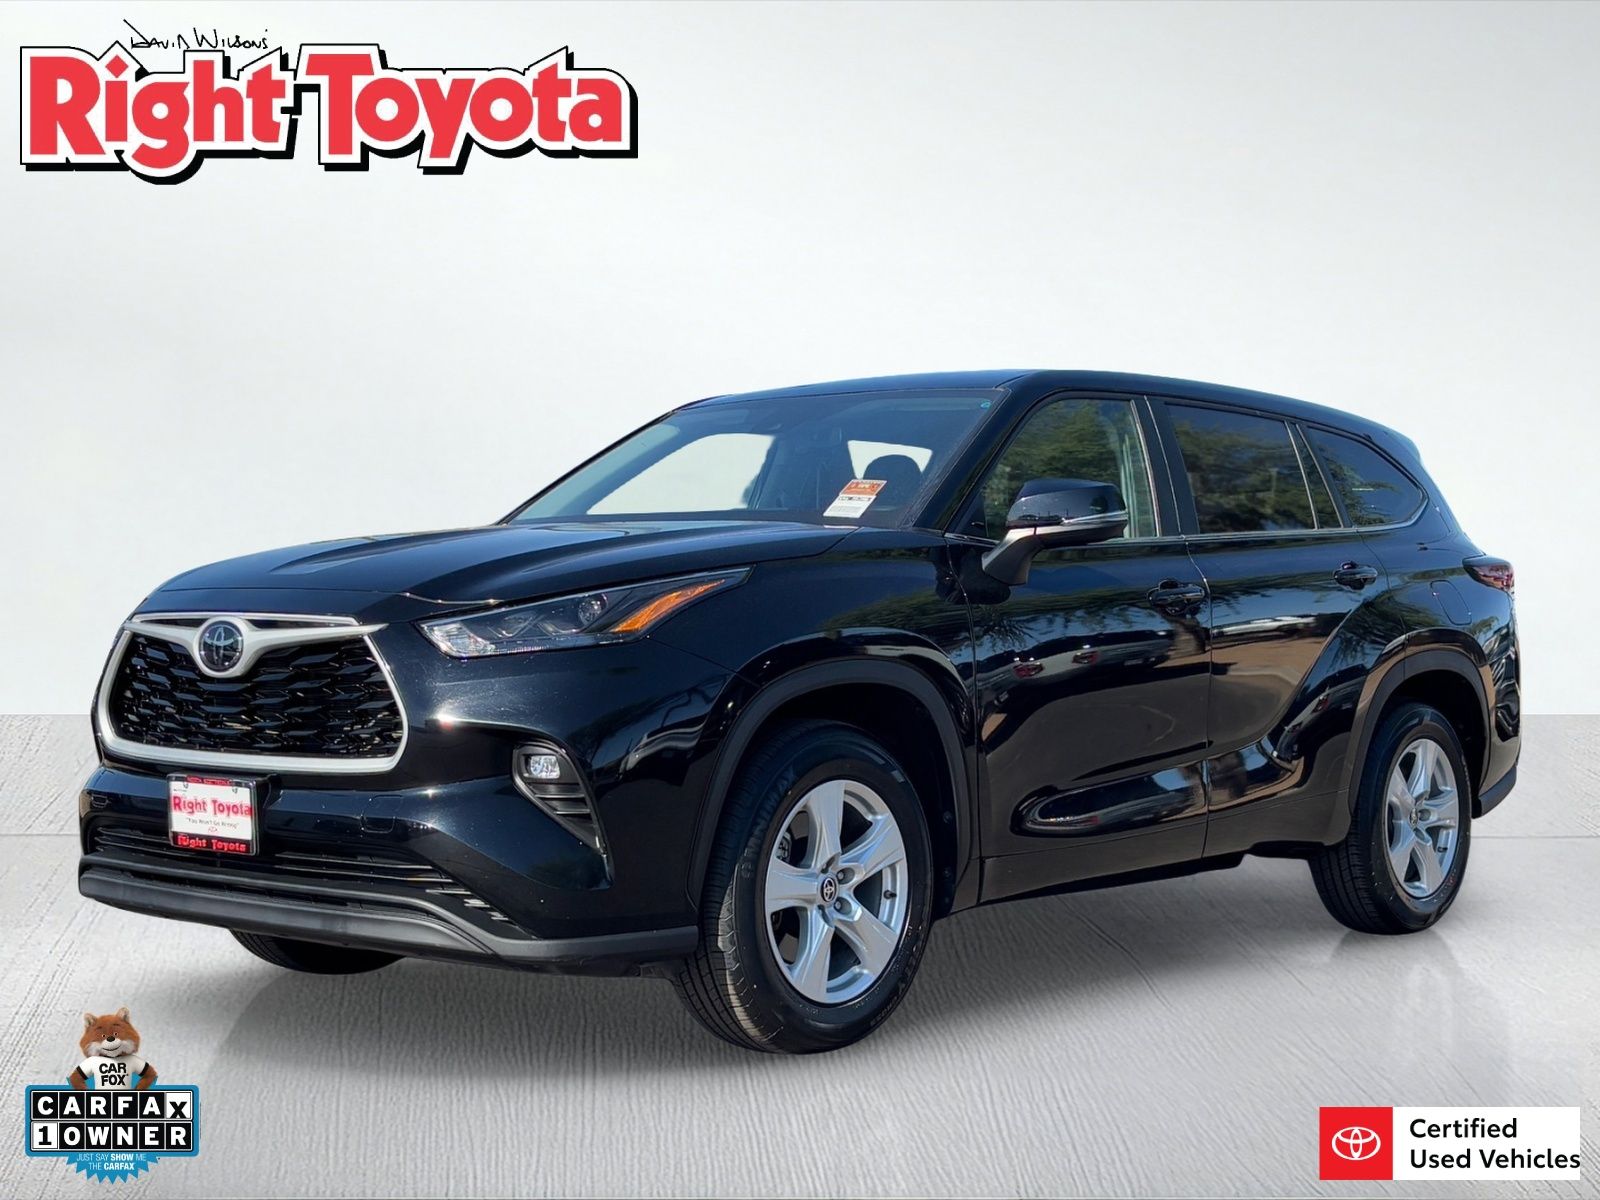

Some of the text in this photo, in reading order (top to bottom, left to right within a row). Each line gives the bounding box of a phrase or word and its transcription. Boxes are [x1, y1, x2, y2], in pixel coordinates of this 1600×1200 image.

[173, 796, 252, 818] Right Toyota
[177, 834, 247, 852] Right Toyota
